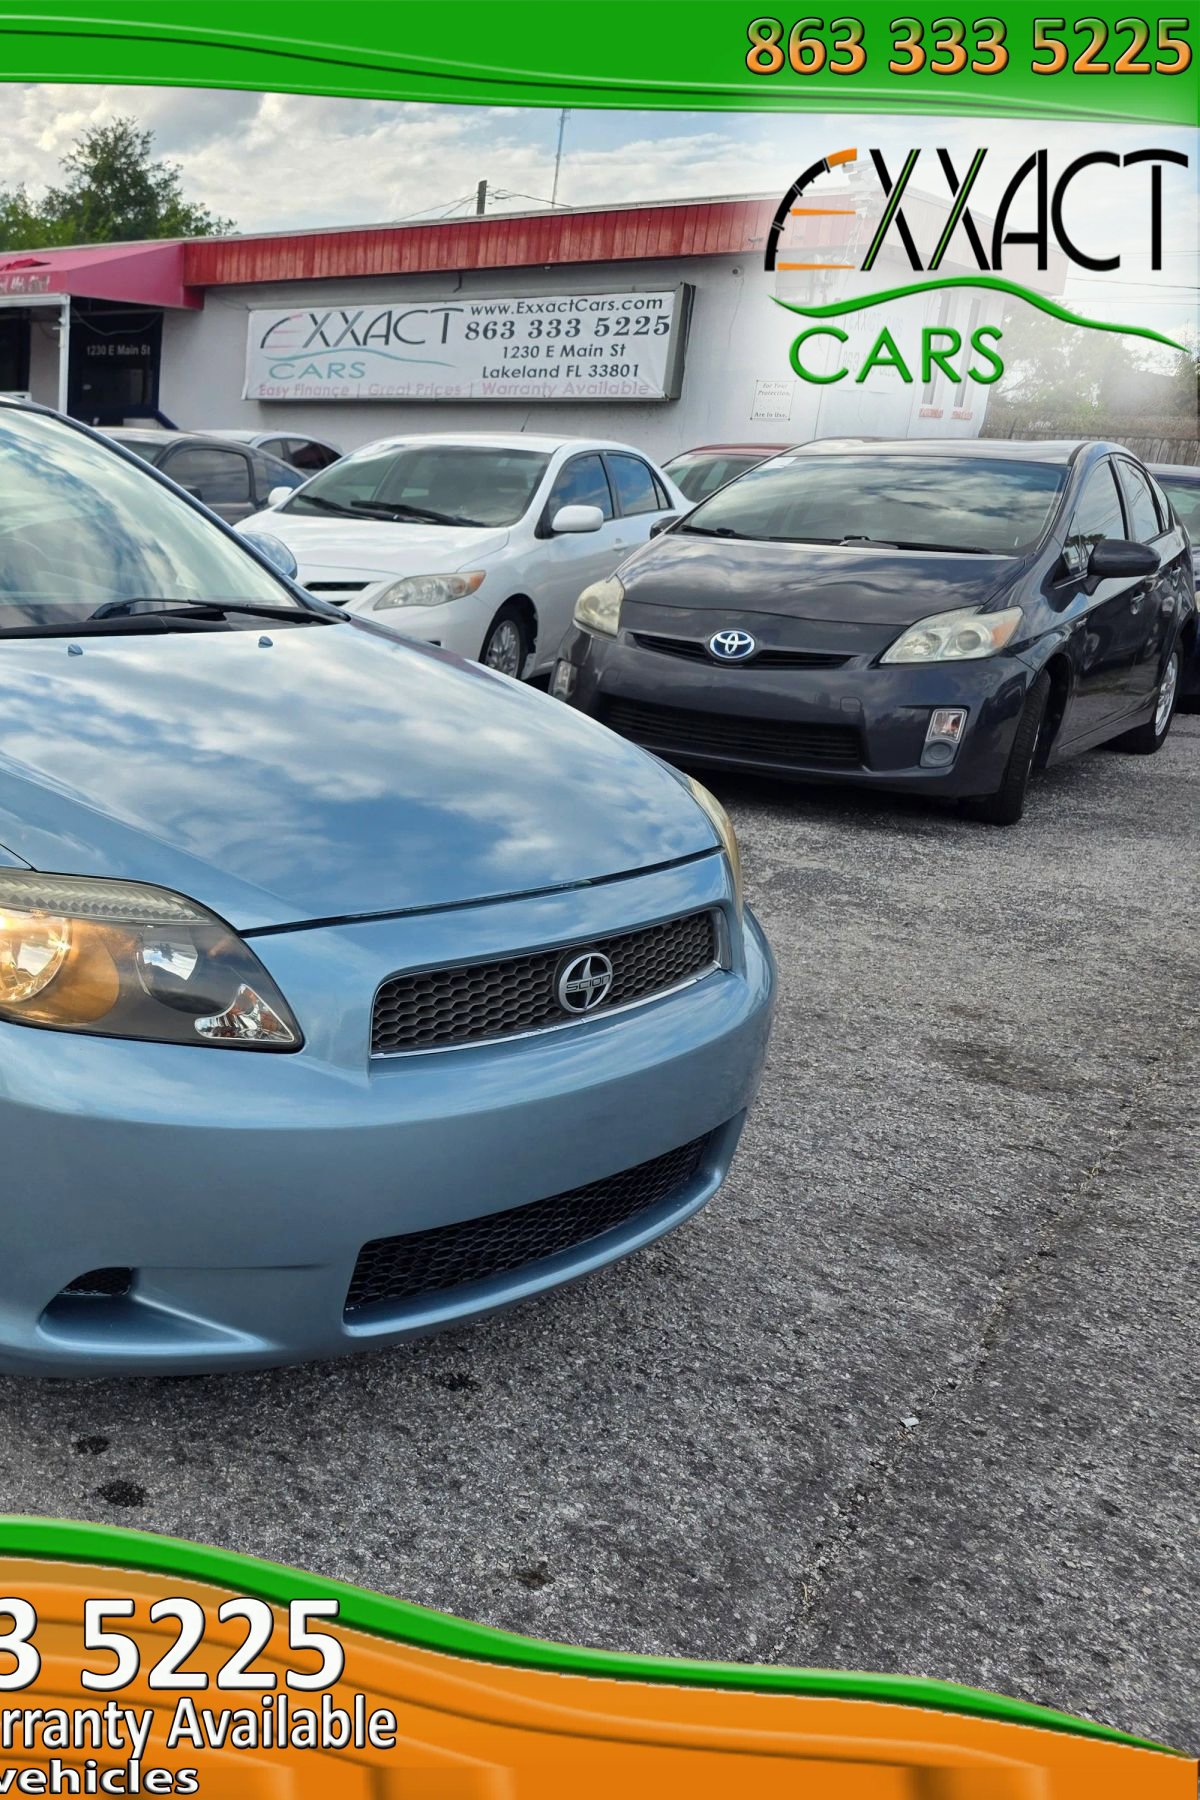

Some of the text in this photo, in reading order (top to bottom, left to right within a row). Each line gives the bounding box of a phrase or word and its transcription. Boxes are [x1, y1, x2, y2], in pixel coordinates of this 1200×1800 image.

[471, 298, 663, 315] www.ExxactCars.com
[260, 307, 464, 349] EXXACT
[465, 314, 670, 340] 863 333 5225
[87, 344, 151, 356] 1230 E Main St
[503, 343, 626, 359] 1230 E Main St
[268, 362, 366, 380] CARS
[482, 364, 639, 379] Lakeland FL 33801
[259, 383, 350, 398] Easy Finance
[368, 382, 461, 396] Great Prices
[482, 380, 650, 398] Warranty Available
